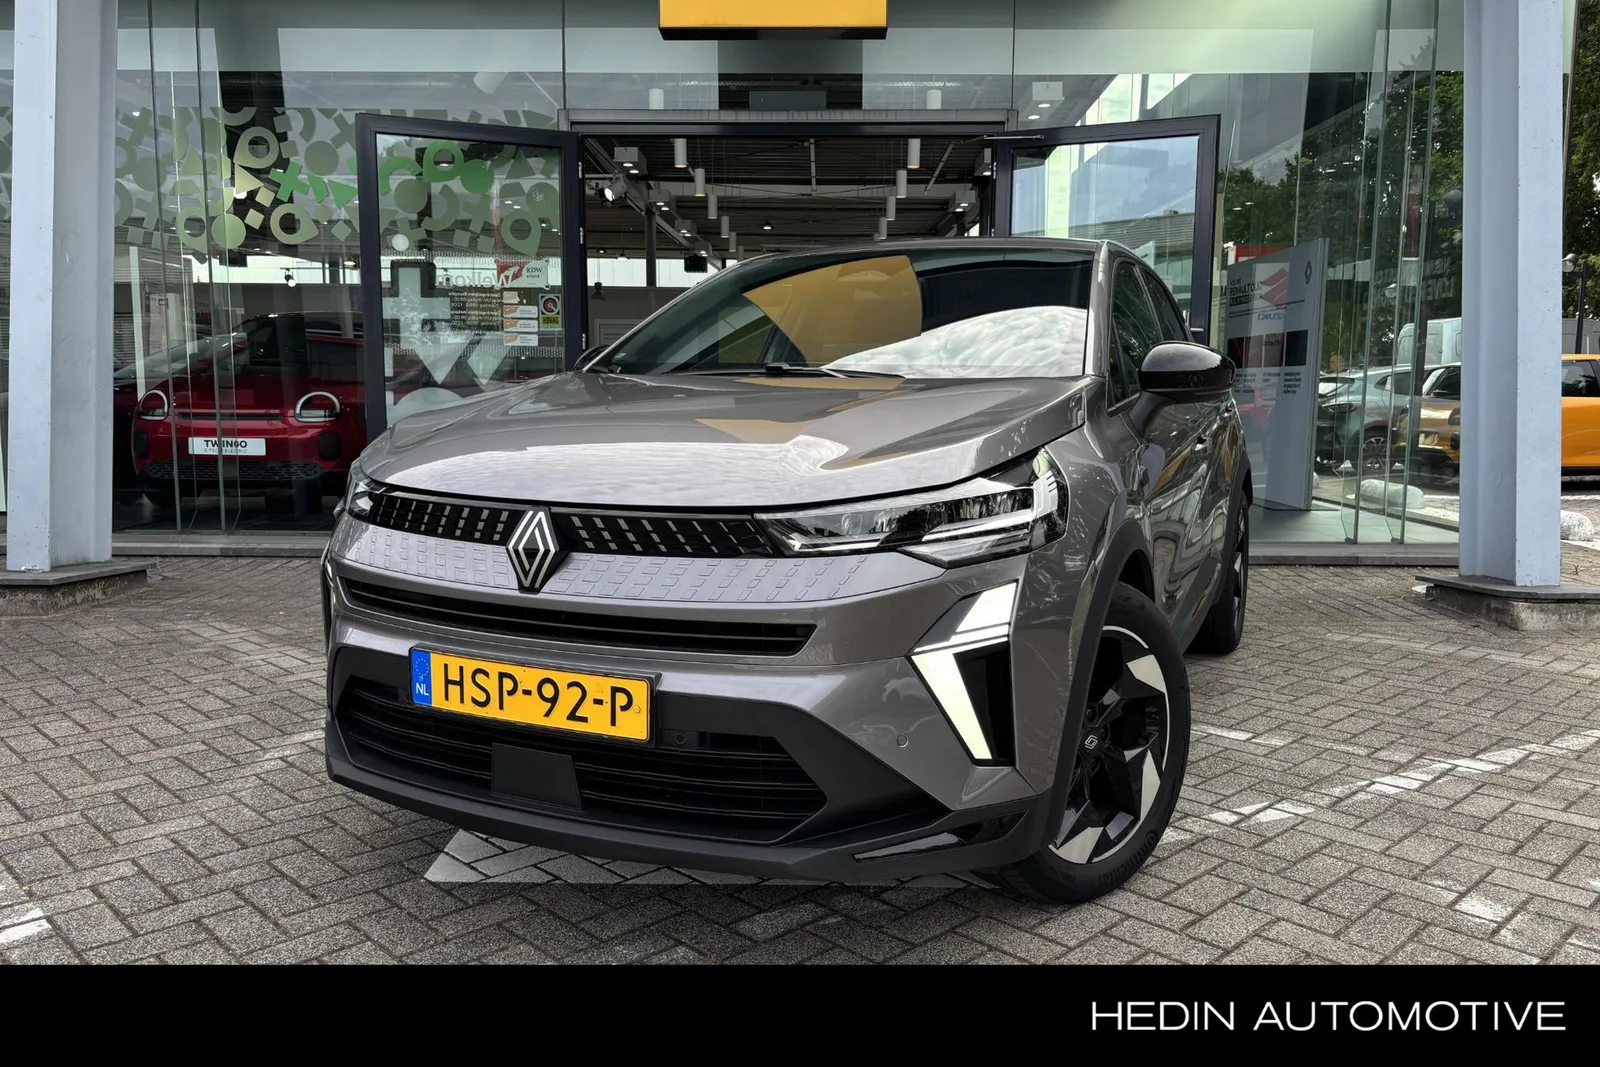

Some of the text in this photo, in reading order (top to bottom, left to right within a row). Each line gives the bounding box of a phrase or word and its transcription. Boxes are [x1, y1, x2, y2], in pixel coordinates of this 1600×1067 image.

[204, 440, 248, 448] TWINGO
[415, 682, 430, 697] NL
[443, 662, 634, 727] HSP-92-P
